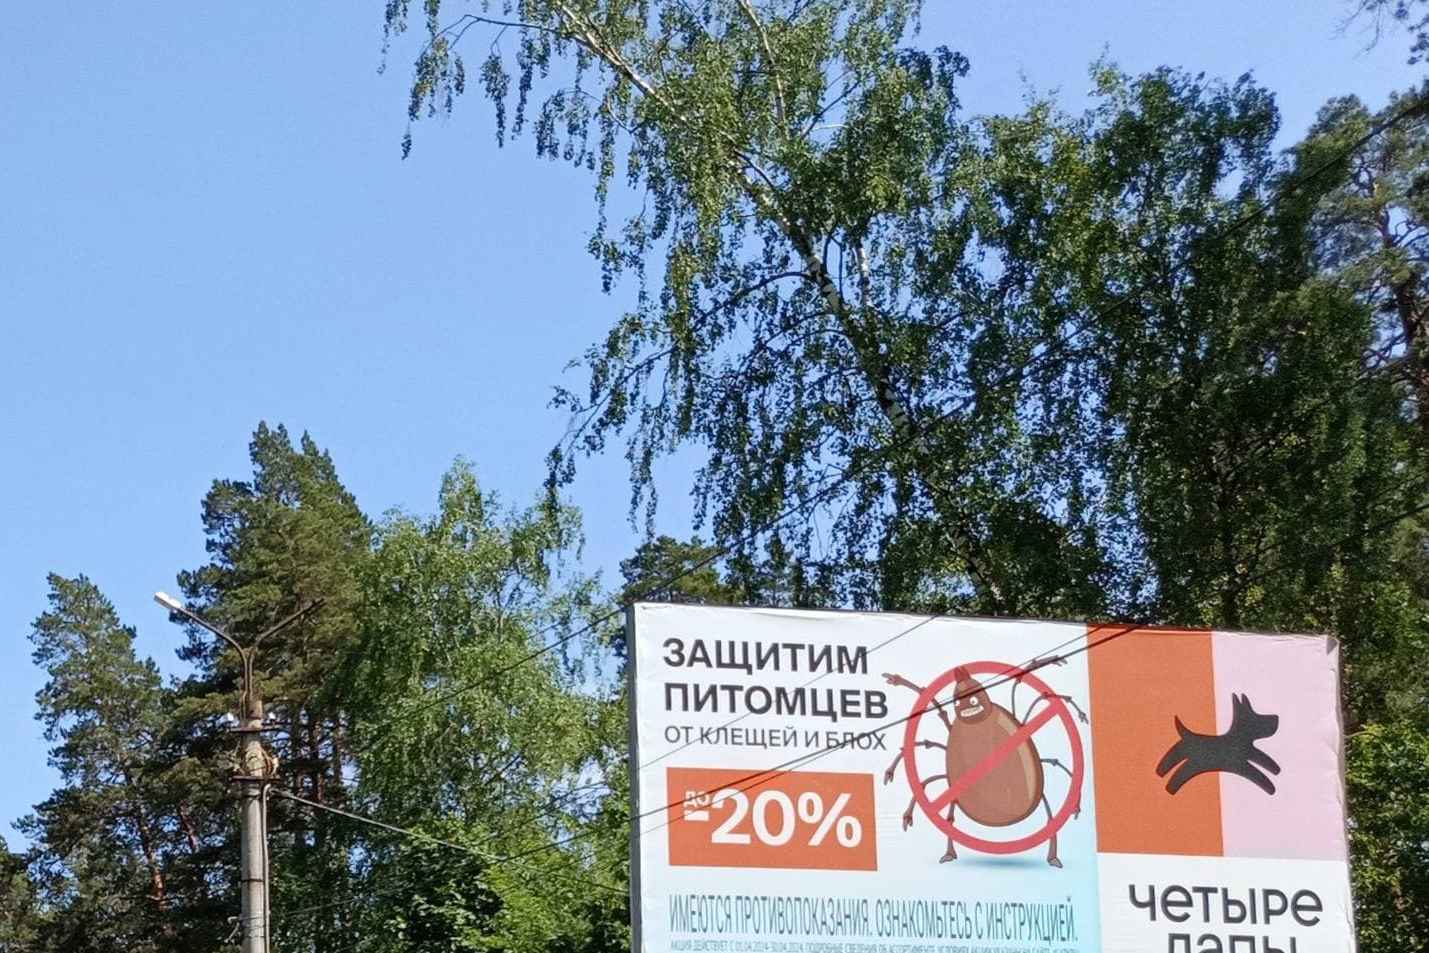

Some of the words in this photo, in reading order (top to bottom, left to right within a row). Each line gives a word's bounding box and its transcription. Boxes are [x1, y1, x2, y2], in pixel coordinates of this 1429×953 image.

[662, 637, 868, 675] ЗАЩИТИМ
[664, 682, 889, 723] ПИТОМЦЕВ
[664, 725, 694, 744] ОТ
[700, 726, 798, 749] КЛЕЩЕЙ
[804, 730, 820, 748] И
[825, 731, 887, 751] БЛОХ
[669, 894, 732, 933] ИМЕЮТСЯ
[735, 895, 873, 937] ПРОТИВОПОКАЗАНИЯ.
[876, 898, 972, 940] ОЗНАКОМЬТЕСЬ
[974, 901, 984, 940] С
[986, 896, 1078, 945] ИНСТРУКЦИЕЙ.
